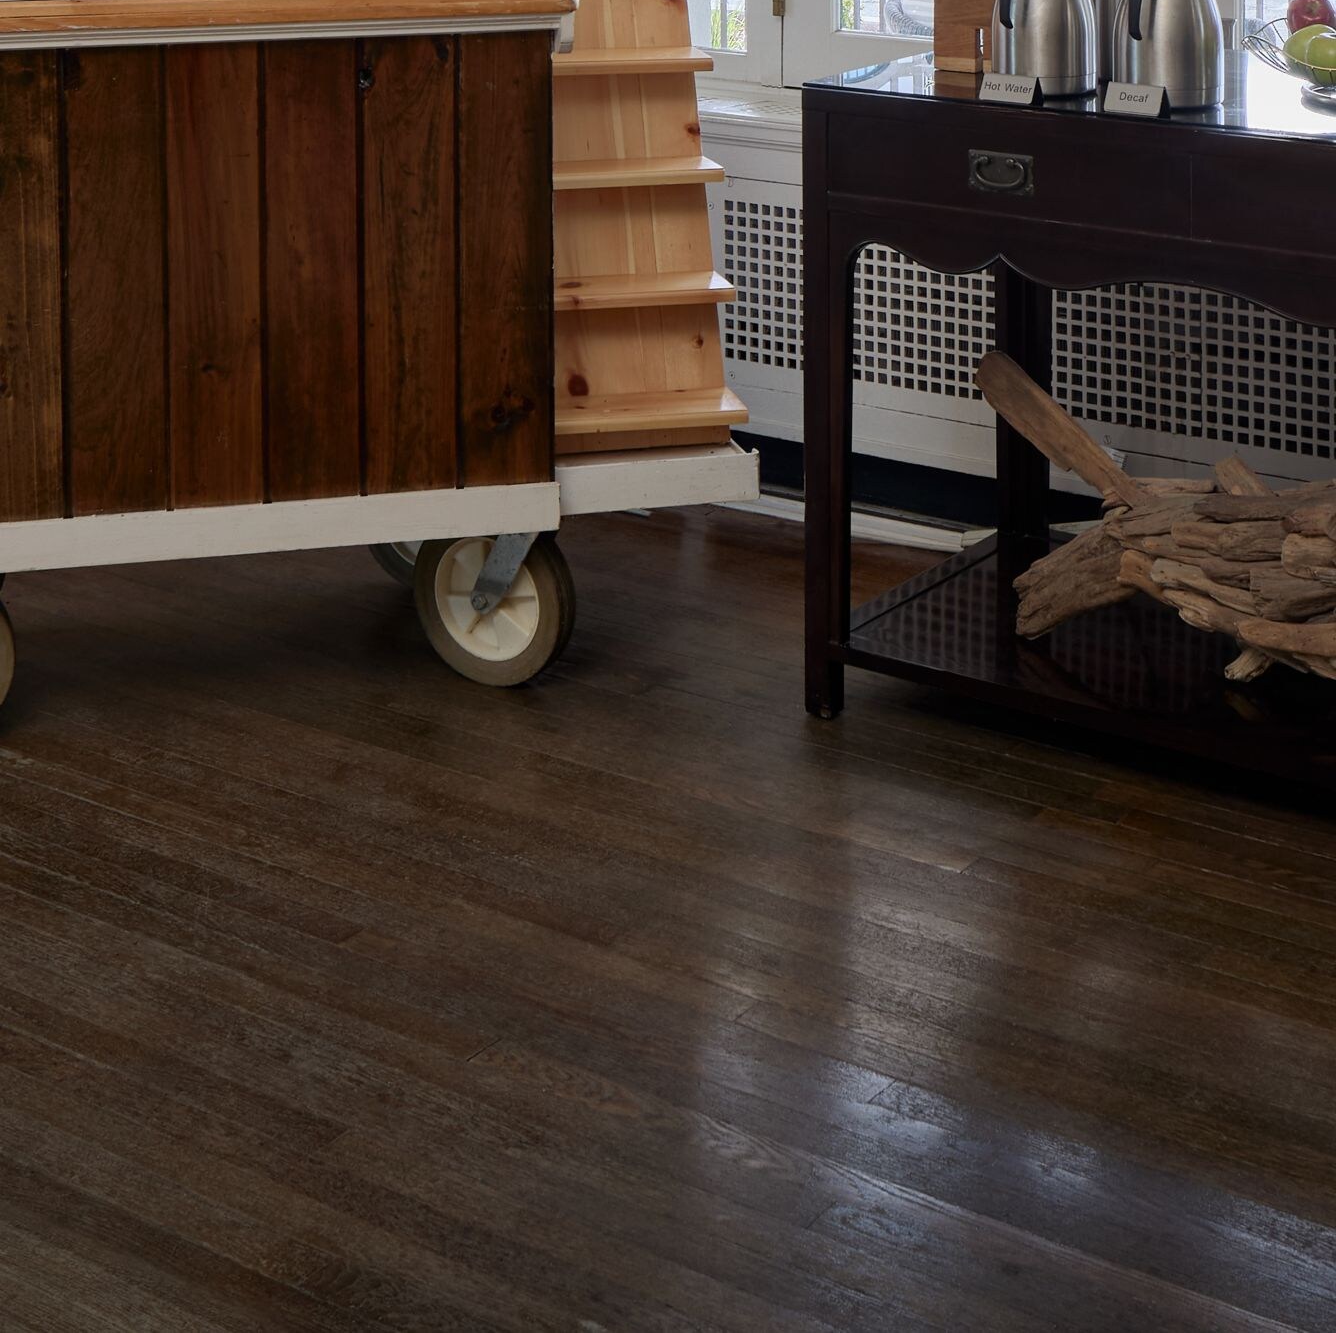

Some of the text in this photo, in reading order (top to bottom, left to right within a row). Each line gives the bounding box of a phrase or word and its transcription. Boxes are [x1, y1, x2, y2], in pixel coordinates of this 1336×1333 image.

[984, 81, 1033, 94] Hot Water
[1119, 92, 1149, 103] Decaf
